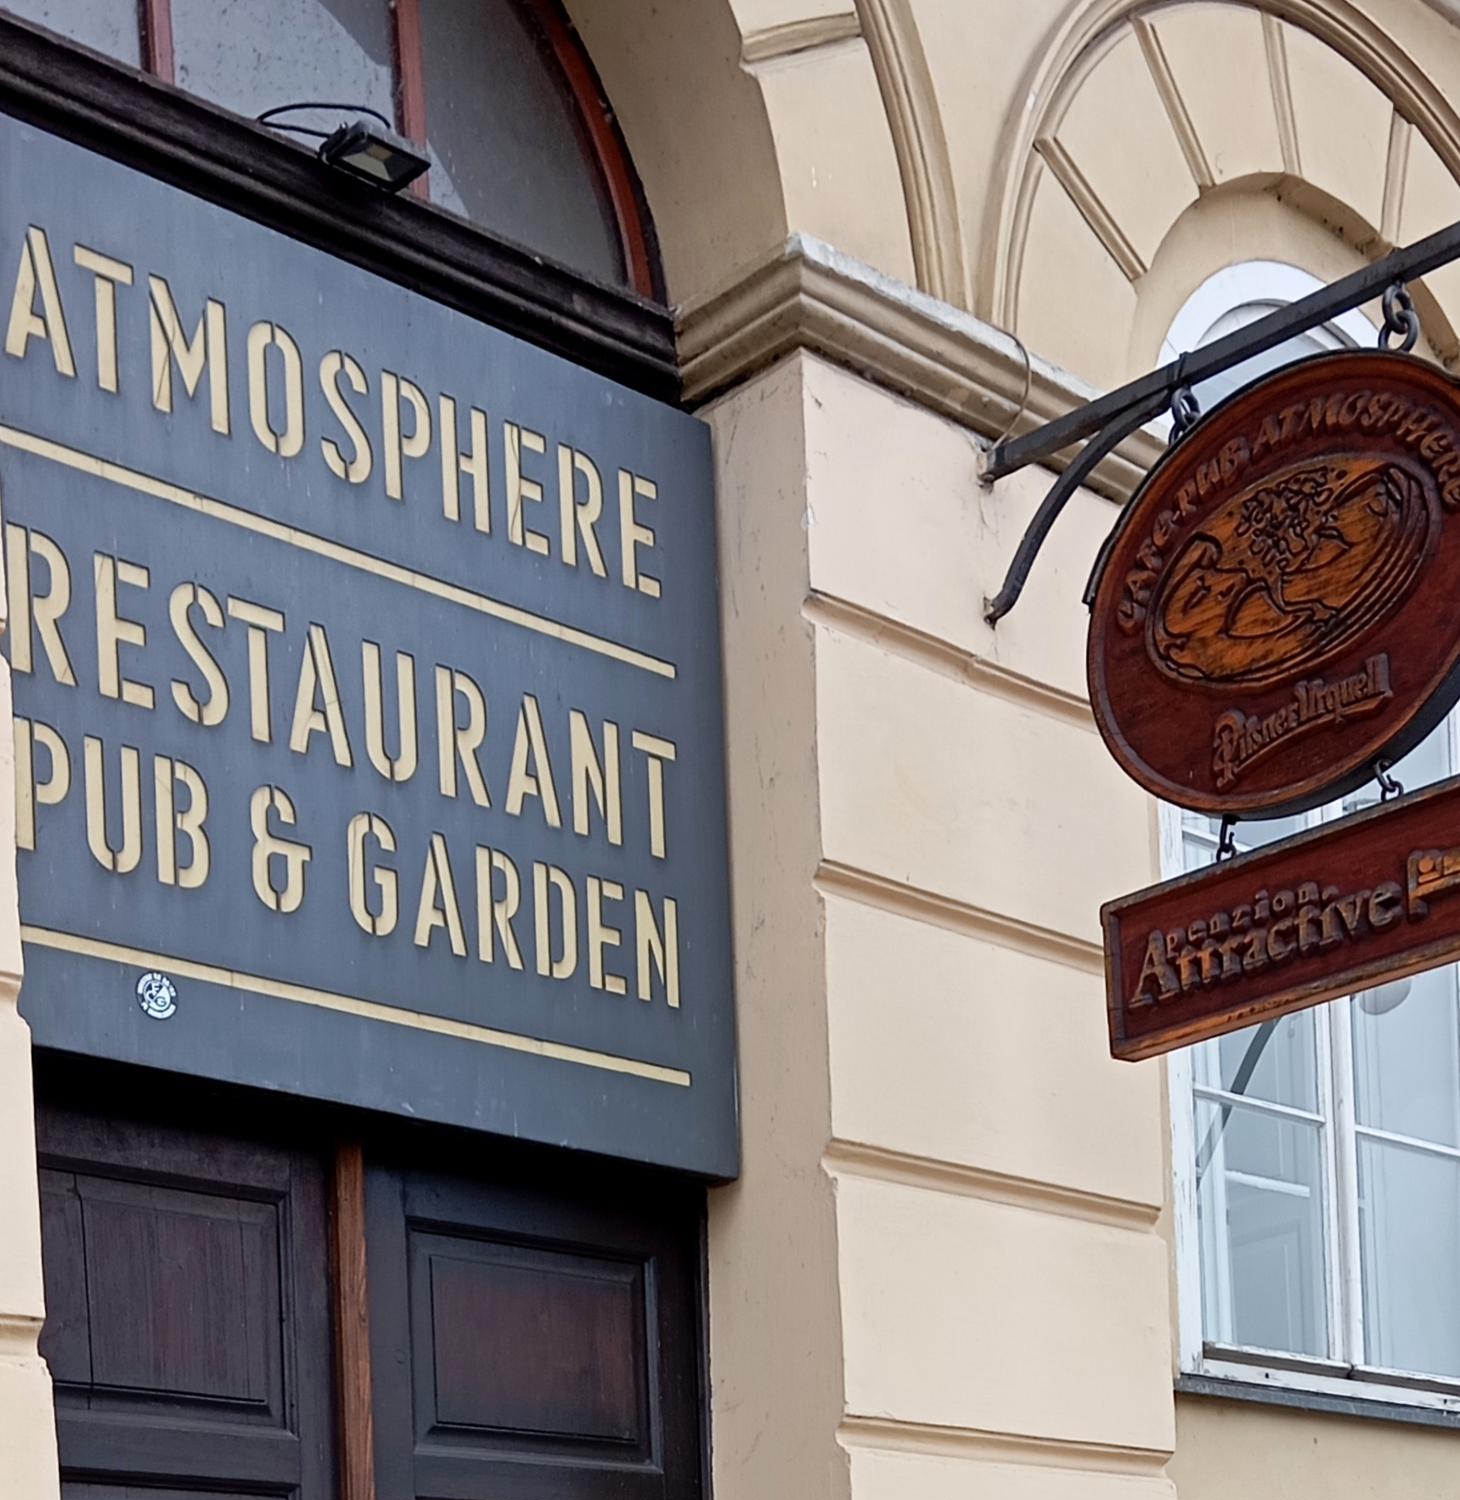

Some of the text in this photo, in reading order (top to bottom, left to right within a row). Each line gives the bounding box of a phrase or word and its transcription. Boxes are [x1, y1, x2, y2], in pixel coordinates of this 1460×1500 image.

[6, 224, 661, 599] ATMOSPHERE
[6, 521, 677, 859] RESTAURANT
[14, 714, 680, 1009] PUB & GARDEN
[1129, 881, 1402, 1009] Attractive
